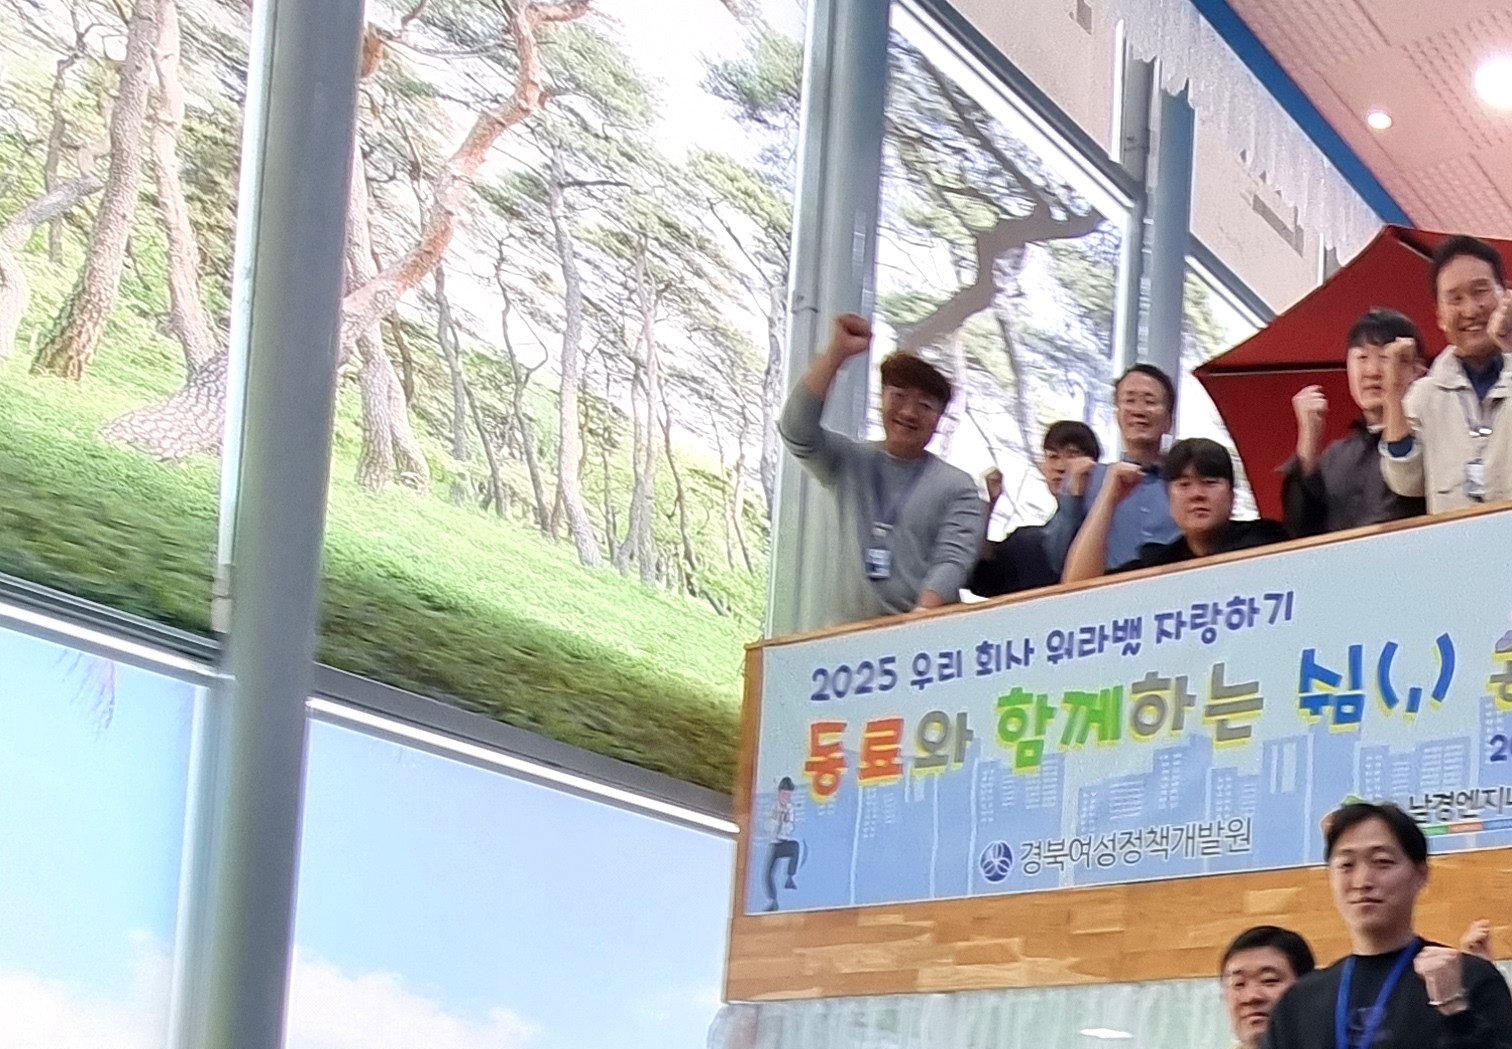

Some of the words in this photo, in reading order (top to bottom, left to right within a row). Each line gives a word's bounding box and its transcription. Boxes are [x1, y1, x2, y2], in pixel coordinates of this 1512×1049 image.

[810, 656, 897, 701] 2025
[910, 649, 963, 692] 우리
[975, 638, 1035, 679] 회사
[1046, 616, 1143, 666] 워라밸
[1154, 590, 1295, 645] 자랑하기
[804, 710, 974, 799] 동료와
[996, 662, 1265, 771] 함께하는
[1018, 816, 1253, 877] 경북여성정책개발원
